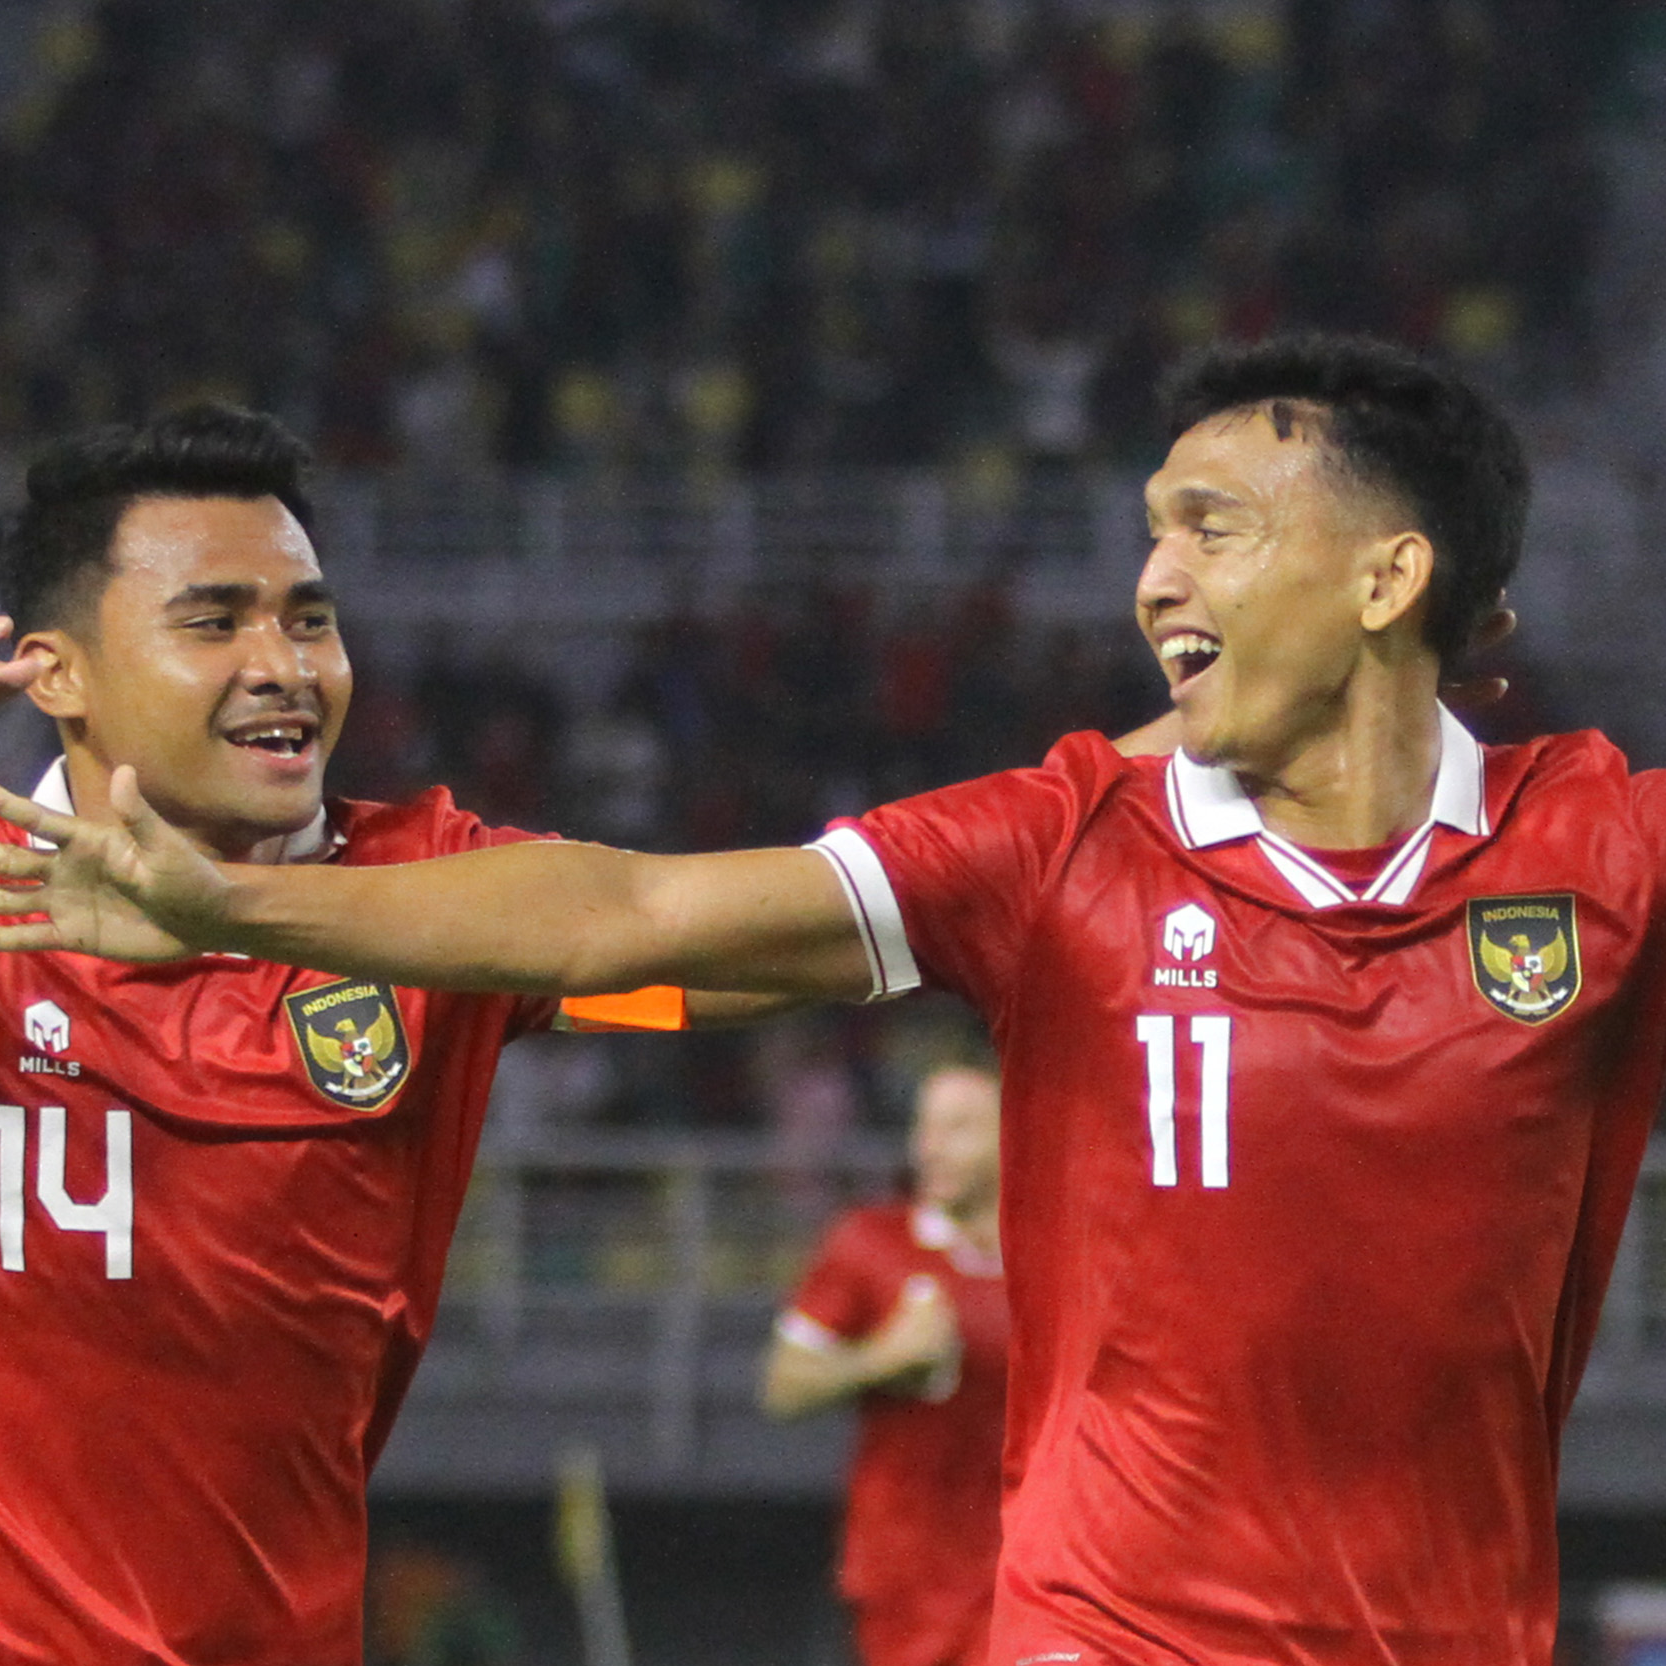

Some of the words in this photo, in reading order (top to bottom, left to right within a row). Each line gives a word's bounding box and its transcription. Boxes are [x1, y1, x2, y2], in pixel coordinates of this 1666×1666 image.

[1482, 905, 1560, 923] INDONESIA
[1154, 967, 1218, 988] MILLS
[301, 984, 381, 1018] INDONESIA
[19, 1056, 81, 1078] MILLS
[1136, 1014, 1231, 1189] 11
